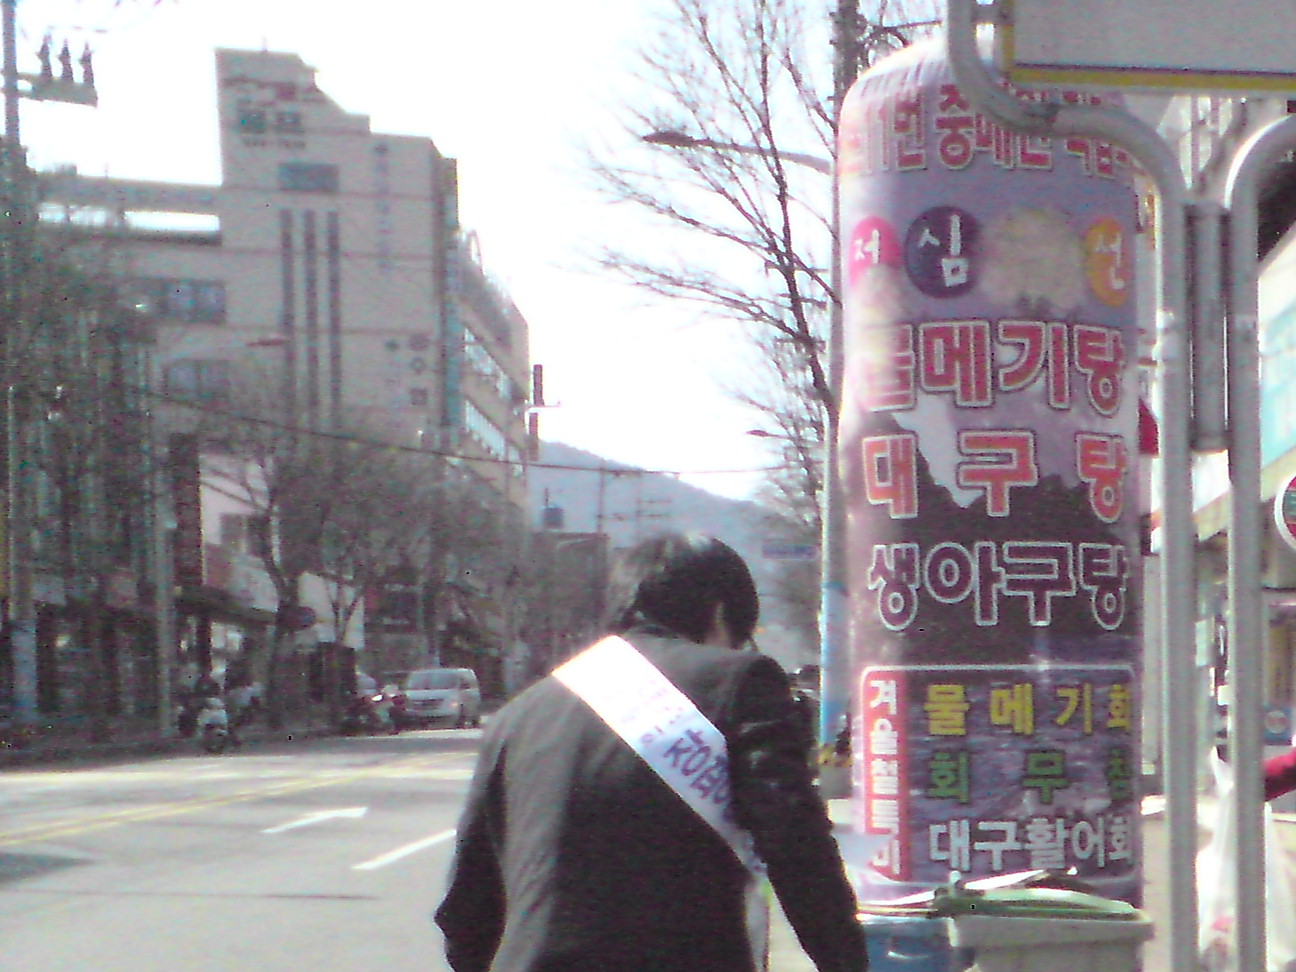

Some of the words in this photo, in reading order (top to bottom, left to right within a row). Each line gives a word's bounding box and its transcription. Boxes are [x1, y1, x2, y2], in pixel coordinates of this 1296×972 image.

[862, 430, 1127, 523] 대구탕
[867, 541, 1127, 631] 생아구탕
[929, 816, 1134, 873] 대구활어회
